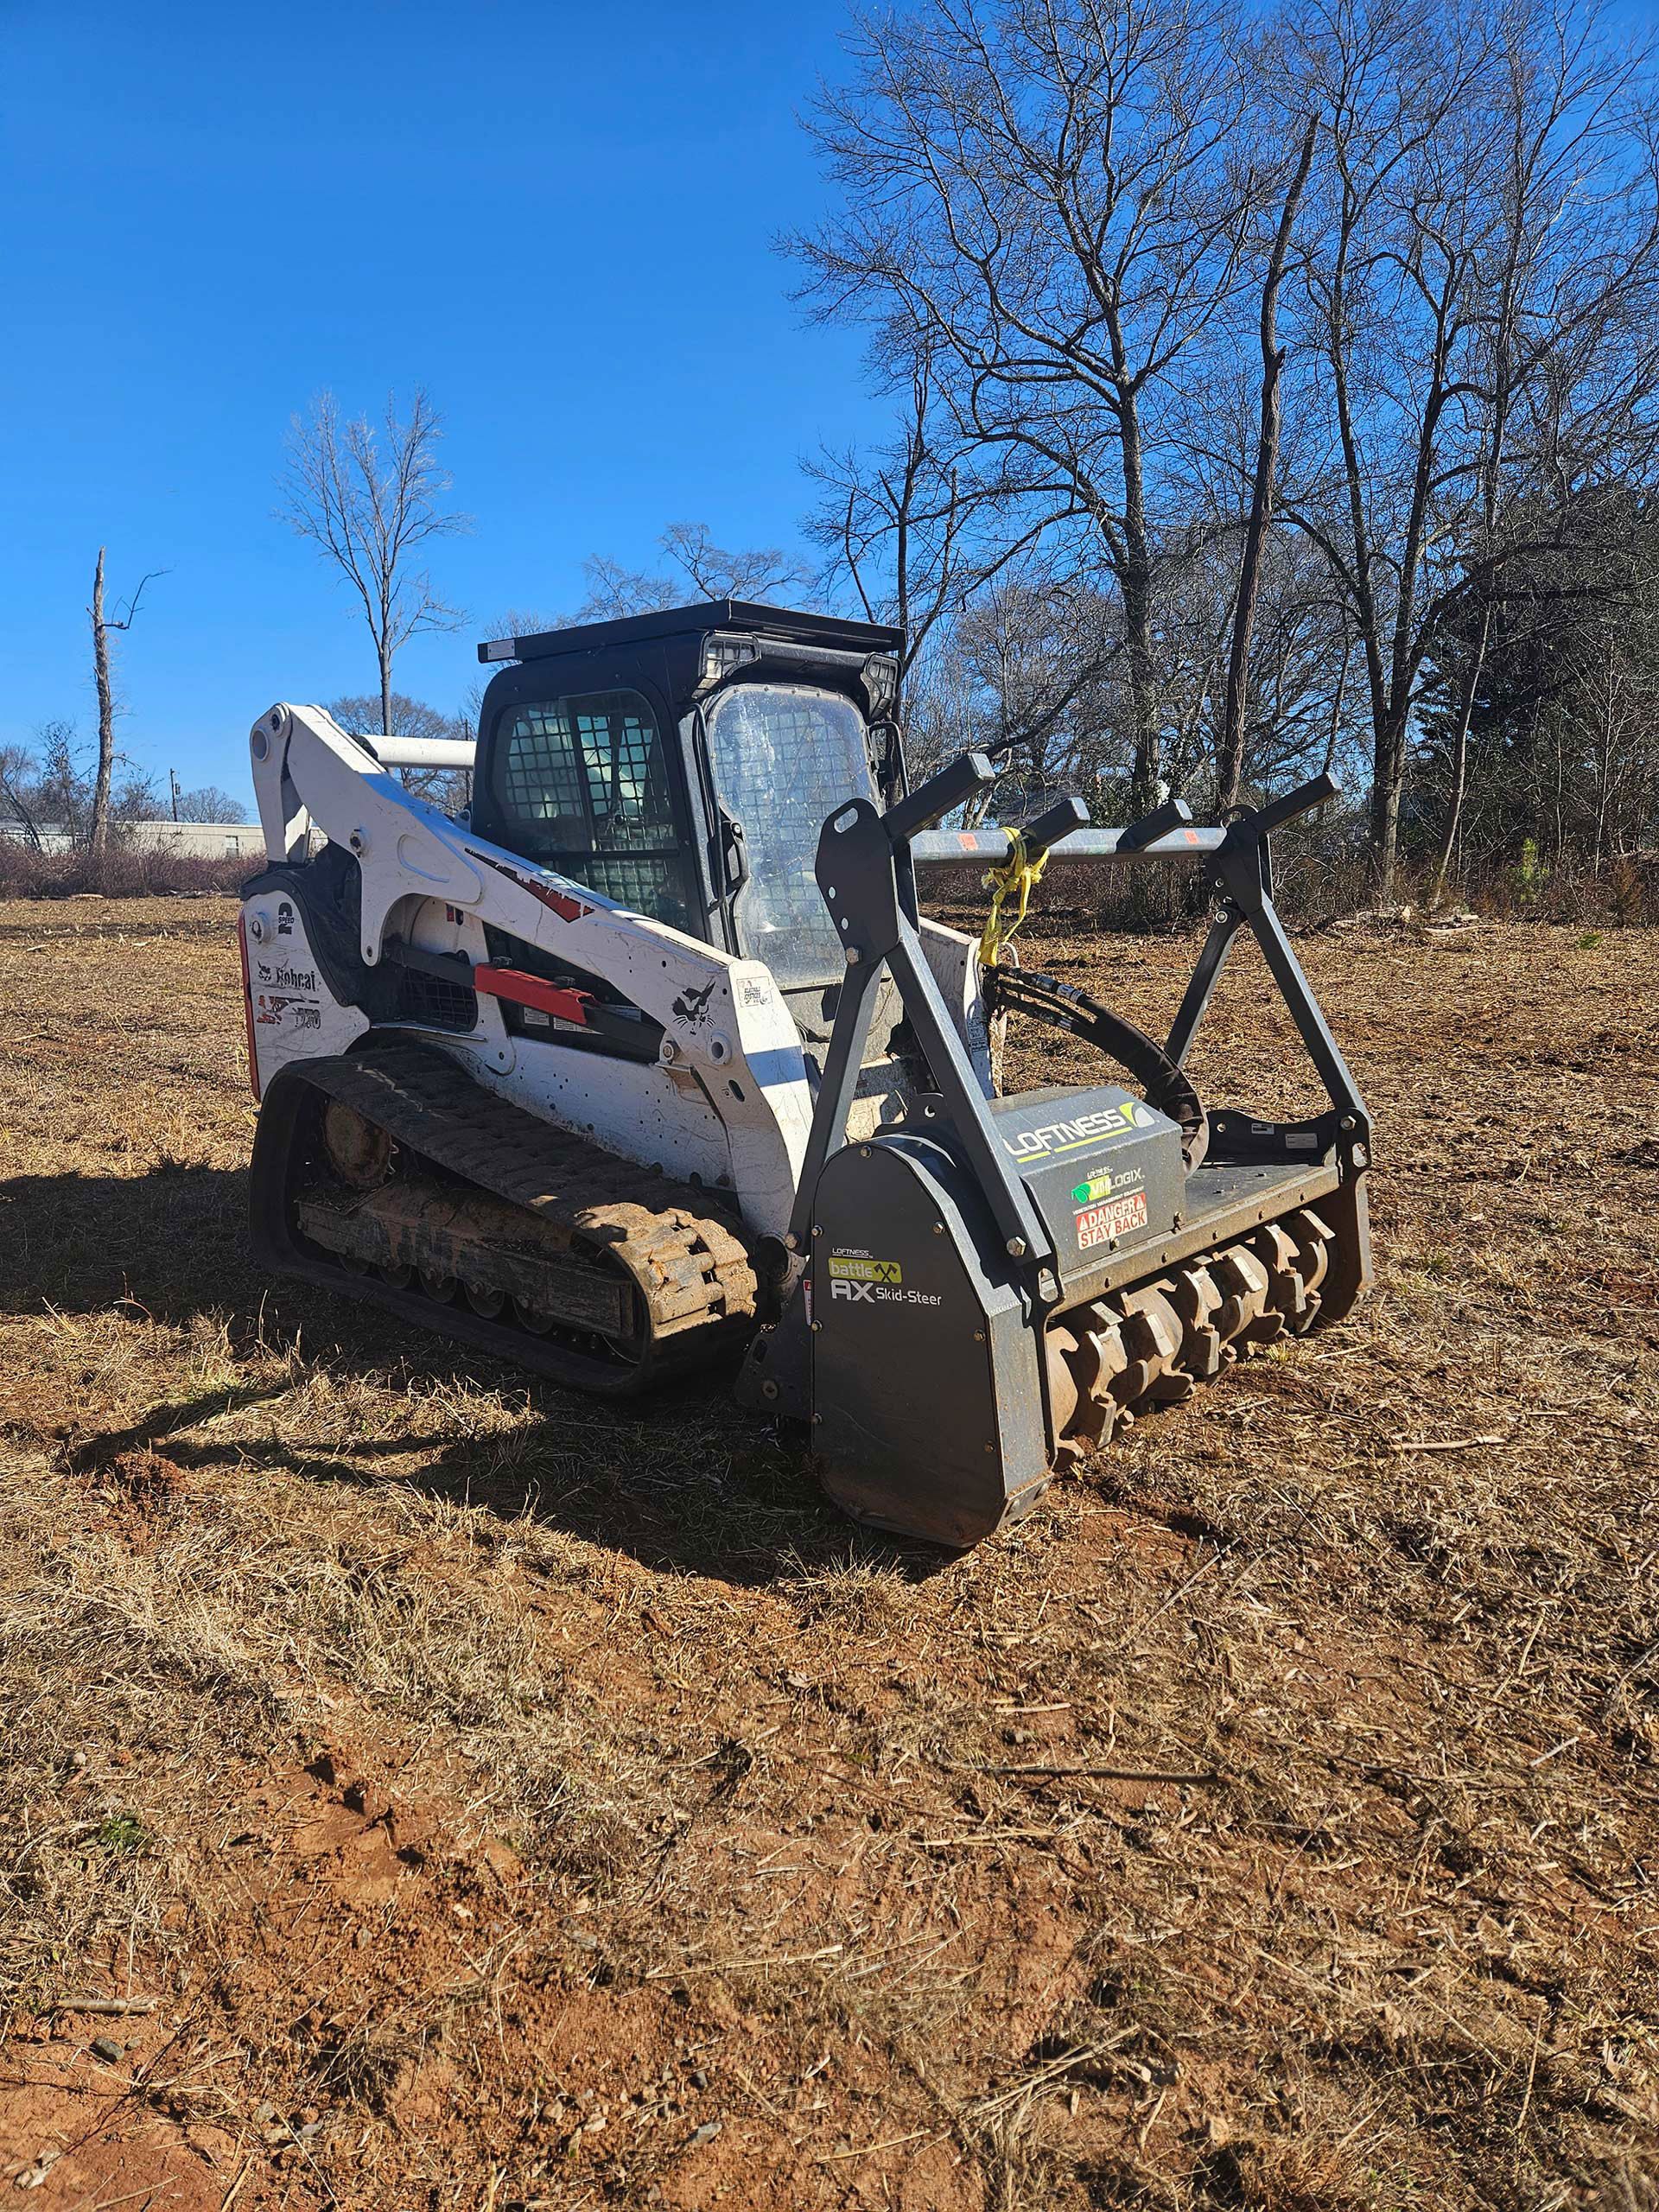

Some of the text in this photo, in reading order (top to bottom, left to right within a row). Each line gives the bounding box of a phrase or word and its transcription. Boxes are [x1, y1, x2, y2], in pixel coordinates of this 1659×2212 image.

[1001, 1109, 1127, 1156] LOFTNESS
[1089, 1196, 1135, 1229] DANGER
[1081, 1210, 1146, 1248] STAY BACK
[832, 1248, 869, 1256] LOFTNESS
[830, 1261, 874, 1279] battle
[830, 1279, 942, 1306] AX Skid-Steer
